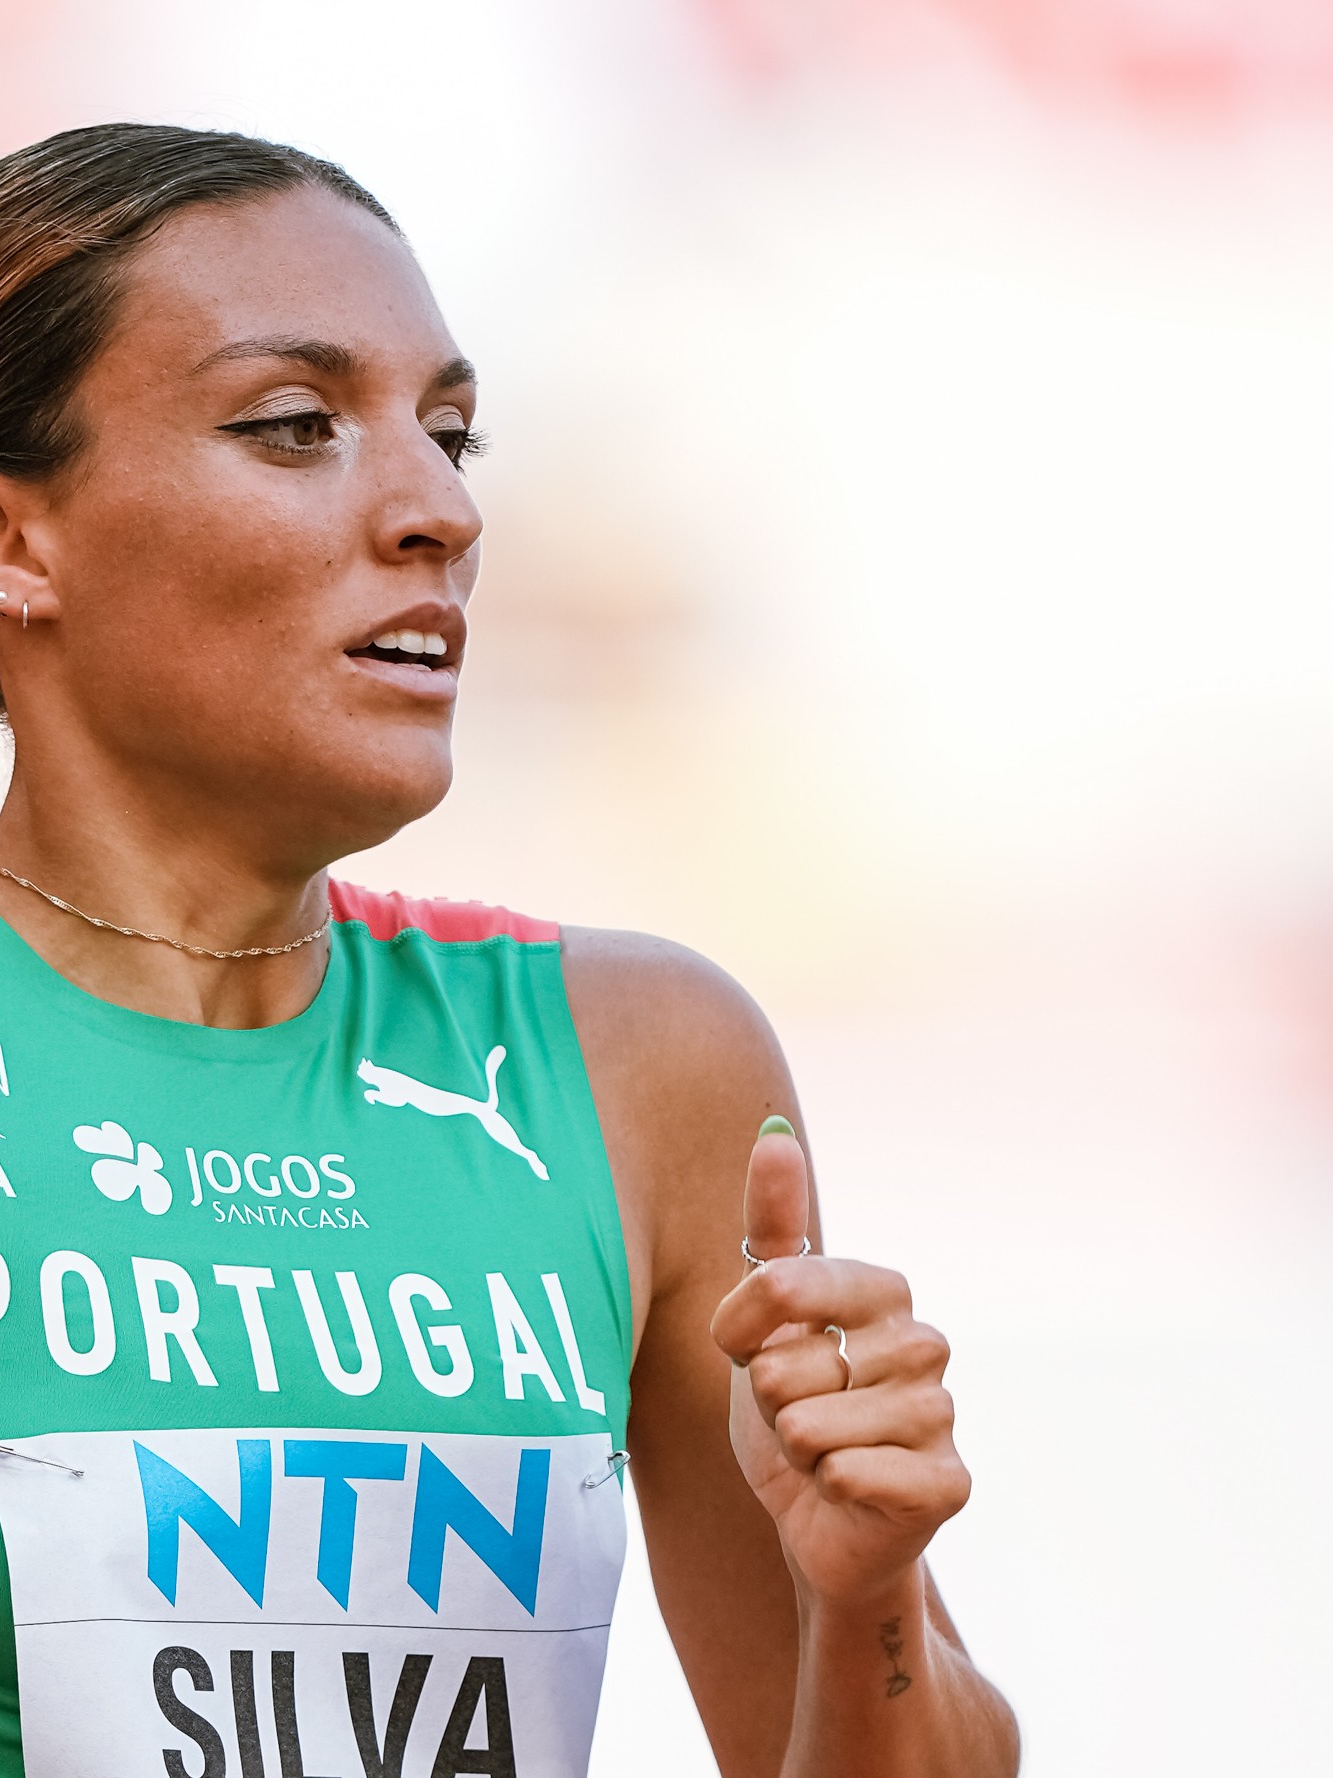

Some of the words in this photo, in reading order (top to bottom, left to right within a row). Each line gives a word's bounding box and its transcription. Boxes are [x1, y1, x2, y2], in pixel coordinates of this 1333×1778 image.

[185, 1147, 356, 1207] JOGOS
[133, 1439, 551, 1617] NTN
[152, 1646, 519, 1778] SILVA
